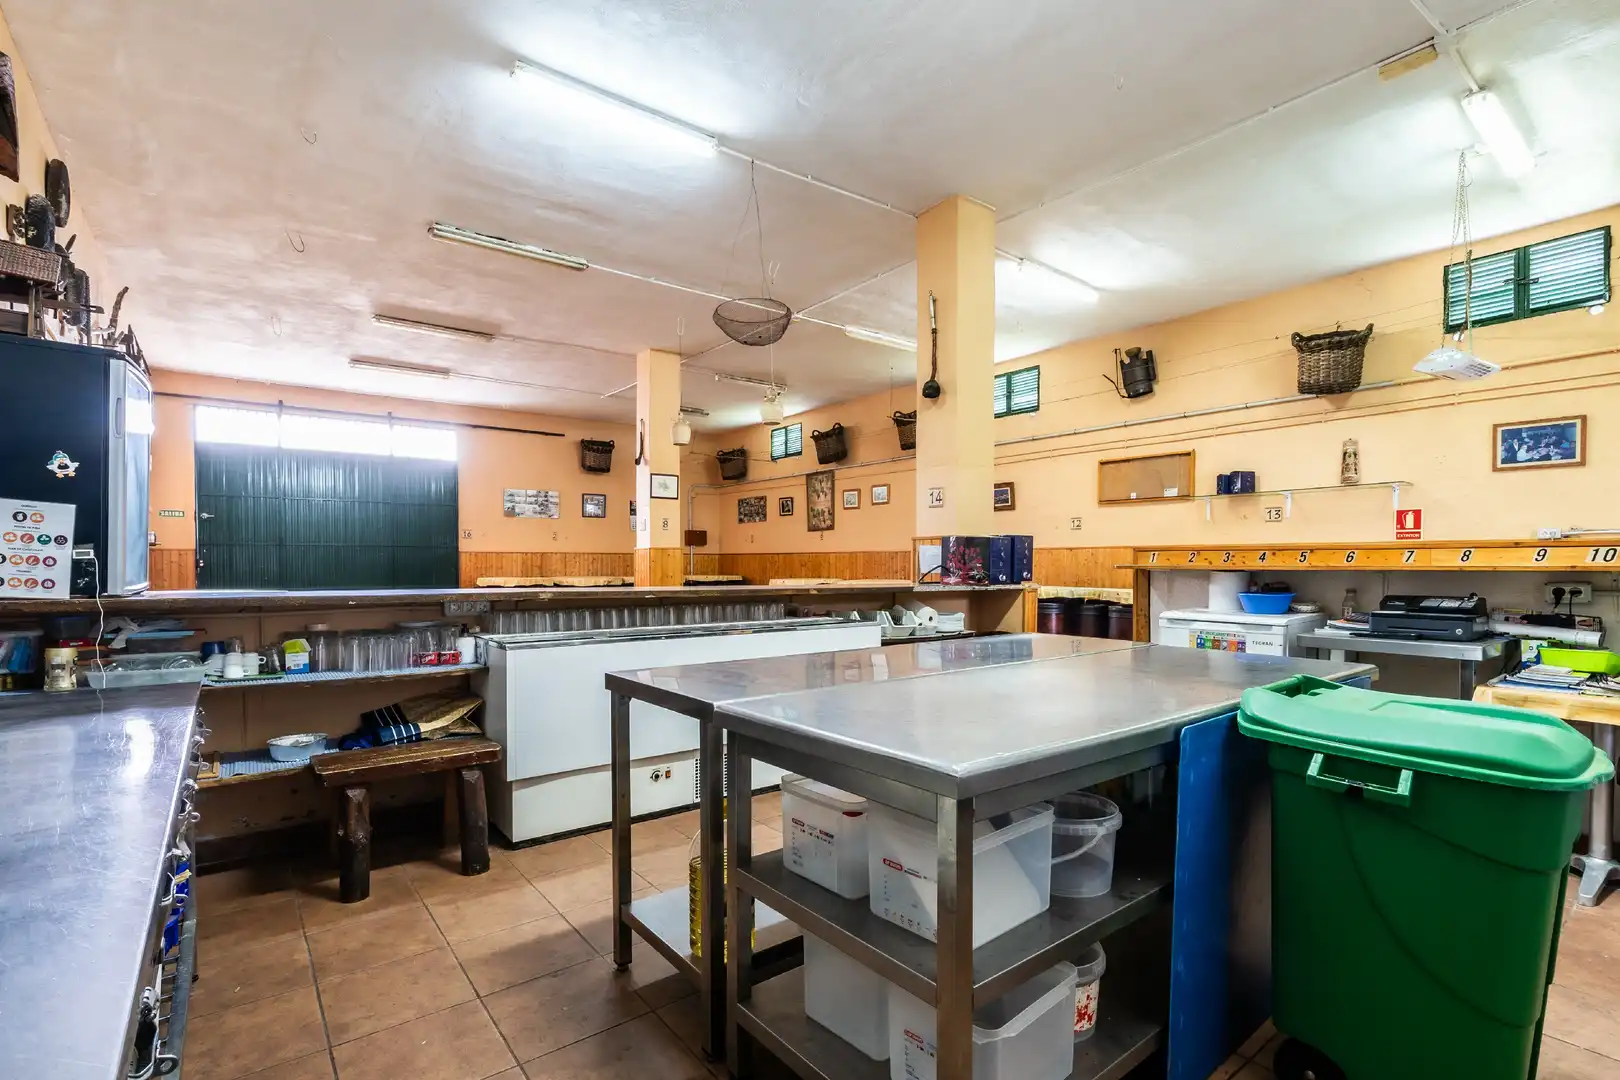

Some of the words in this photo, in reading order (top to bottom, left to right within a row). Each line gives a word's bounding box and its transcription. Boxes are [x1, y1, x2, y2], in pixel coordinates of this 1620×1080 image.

[929, 490, 943, 504] 14
[1266, 509, 1282, 520] 13
[1071, 519, 1082, 528] 12
[463, 530, 472, 538] 16
[1151, 552, 1156, 562] 1
[1188, 552, 1196, 563] 2
[1223, 552, 1231, 562] 3
[1258, 551, 1267, 562] 4
[1299, 551, 1308, 562] 5
[1345, 551, 1356, 563] 6
[1404, 550, 1415, 562] 7
[1460, 550, 1472, 562] 8
[1534, 548, 1548, 562] 9
[1591, 548, 1618, 562] 10
